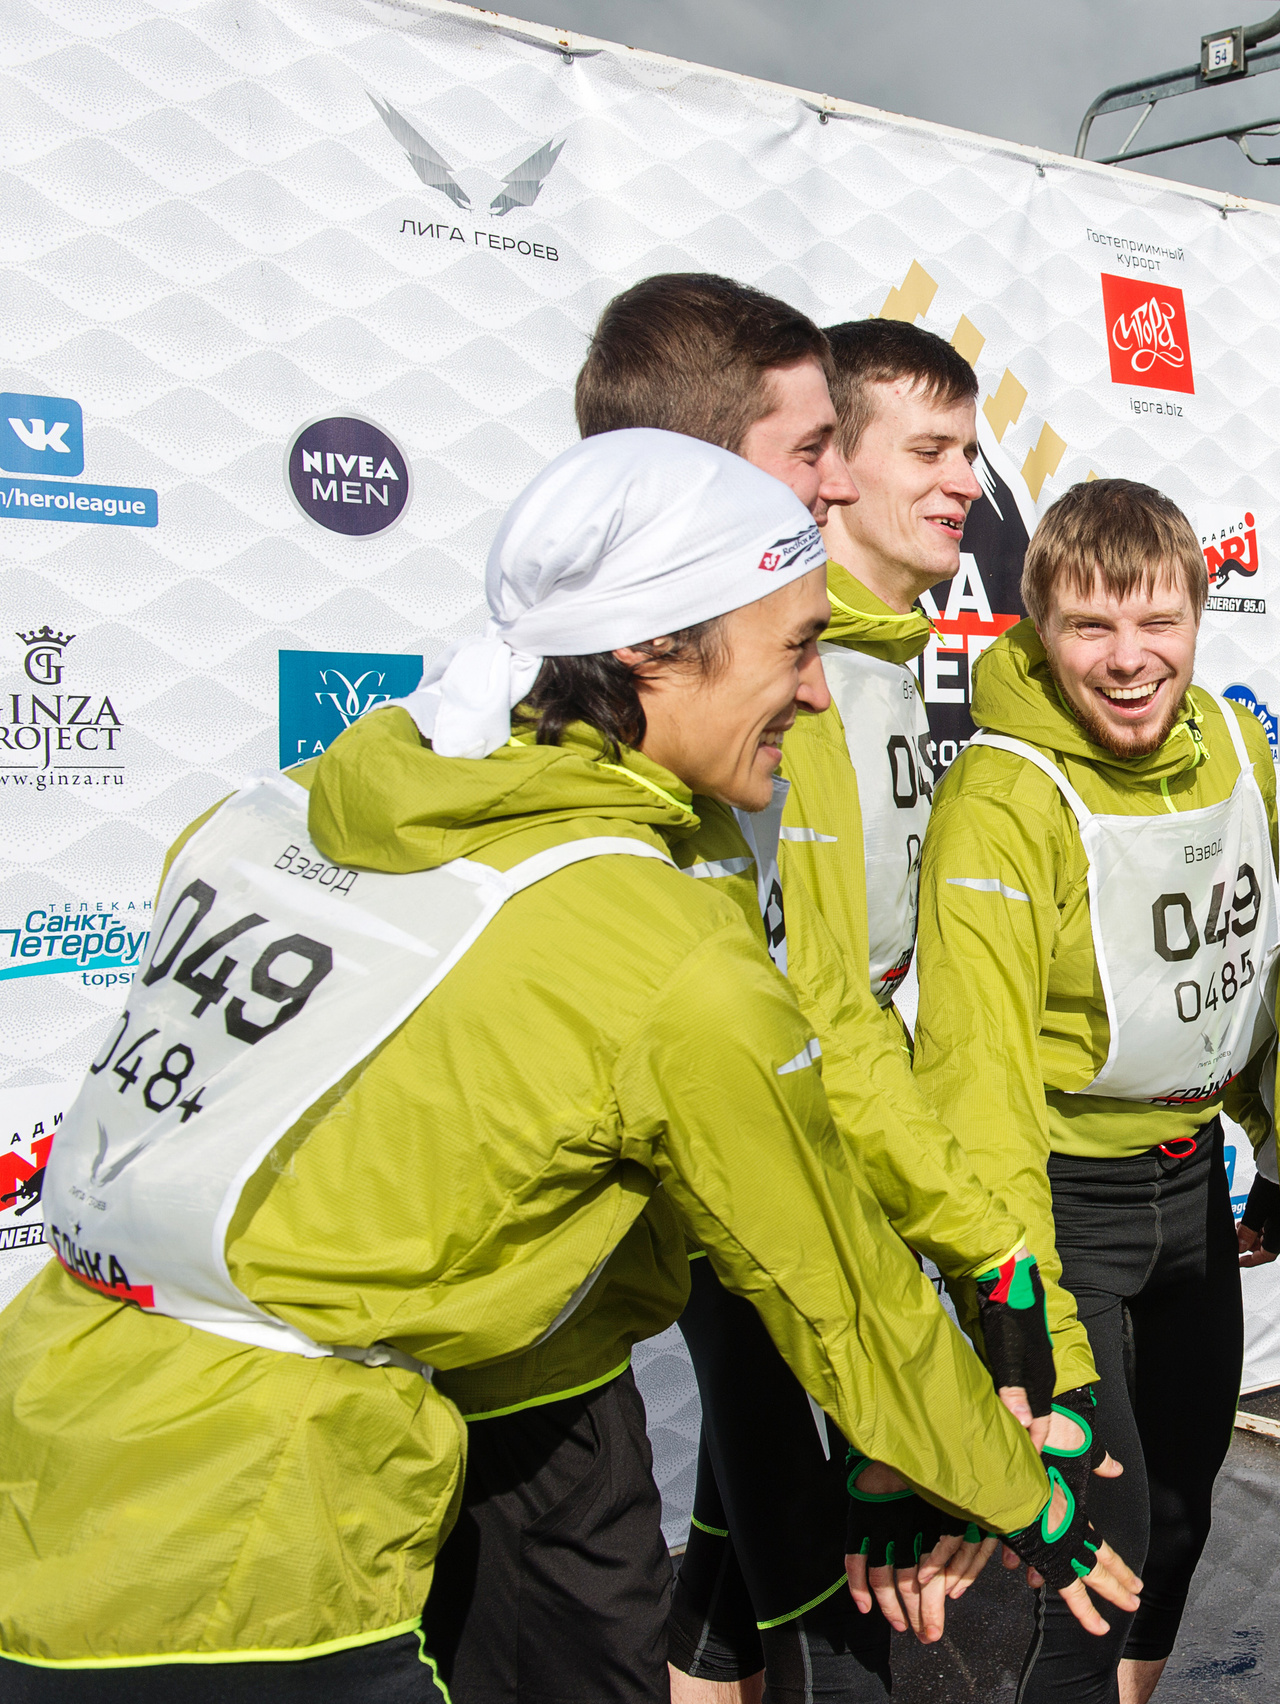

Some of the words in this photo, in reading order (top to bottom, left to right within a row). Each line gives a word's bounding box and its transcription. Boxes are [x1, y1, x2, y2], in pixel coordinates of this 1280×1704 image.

[1214, 48, 1227, 66] 54
[400, 219, 466, 243] ЛИГА
[474, 231, 559, 262] ГЕРОЕВ
[1086, 227, 1185, 262] Гостеприимный
[1116, 253, 1161, 272] курорт
[1129, 397, 1184, 418] igora.biz
[302, 448, 400, 481] NIVEA
[311, 478, 390, 507] MEN
[1201, 521, 1244, 545] РАДИО
[1205, 596, 1242, 612] ENERGY
[1243, 599, 1265, 613] 95.0
[0, 693, 125, 726] INZA
[0, 726, 122, 771] ROJECT
[0, 771, 124, 792] ww.ginza.ru
[1183, 838, 1223, 864] Взвод
[273, 844, 359, 897] Взвод
[25, 910, 121, 934] Санкт-
[48, 900, 153, 913] ТЕЛЕКАН
[1151, 863, 1262, 962] 049
[0, 925, 151, 963] Петербу
[141, 878, 334, 1046] 049
[1174, 949, 1255, 1023] 0485
[10, 1111, 64, 1146] АДИ
